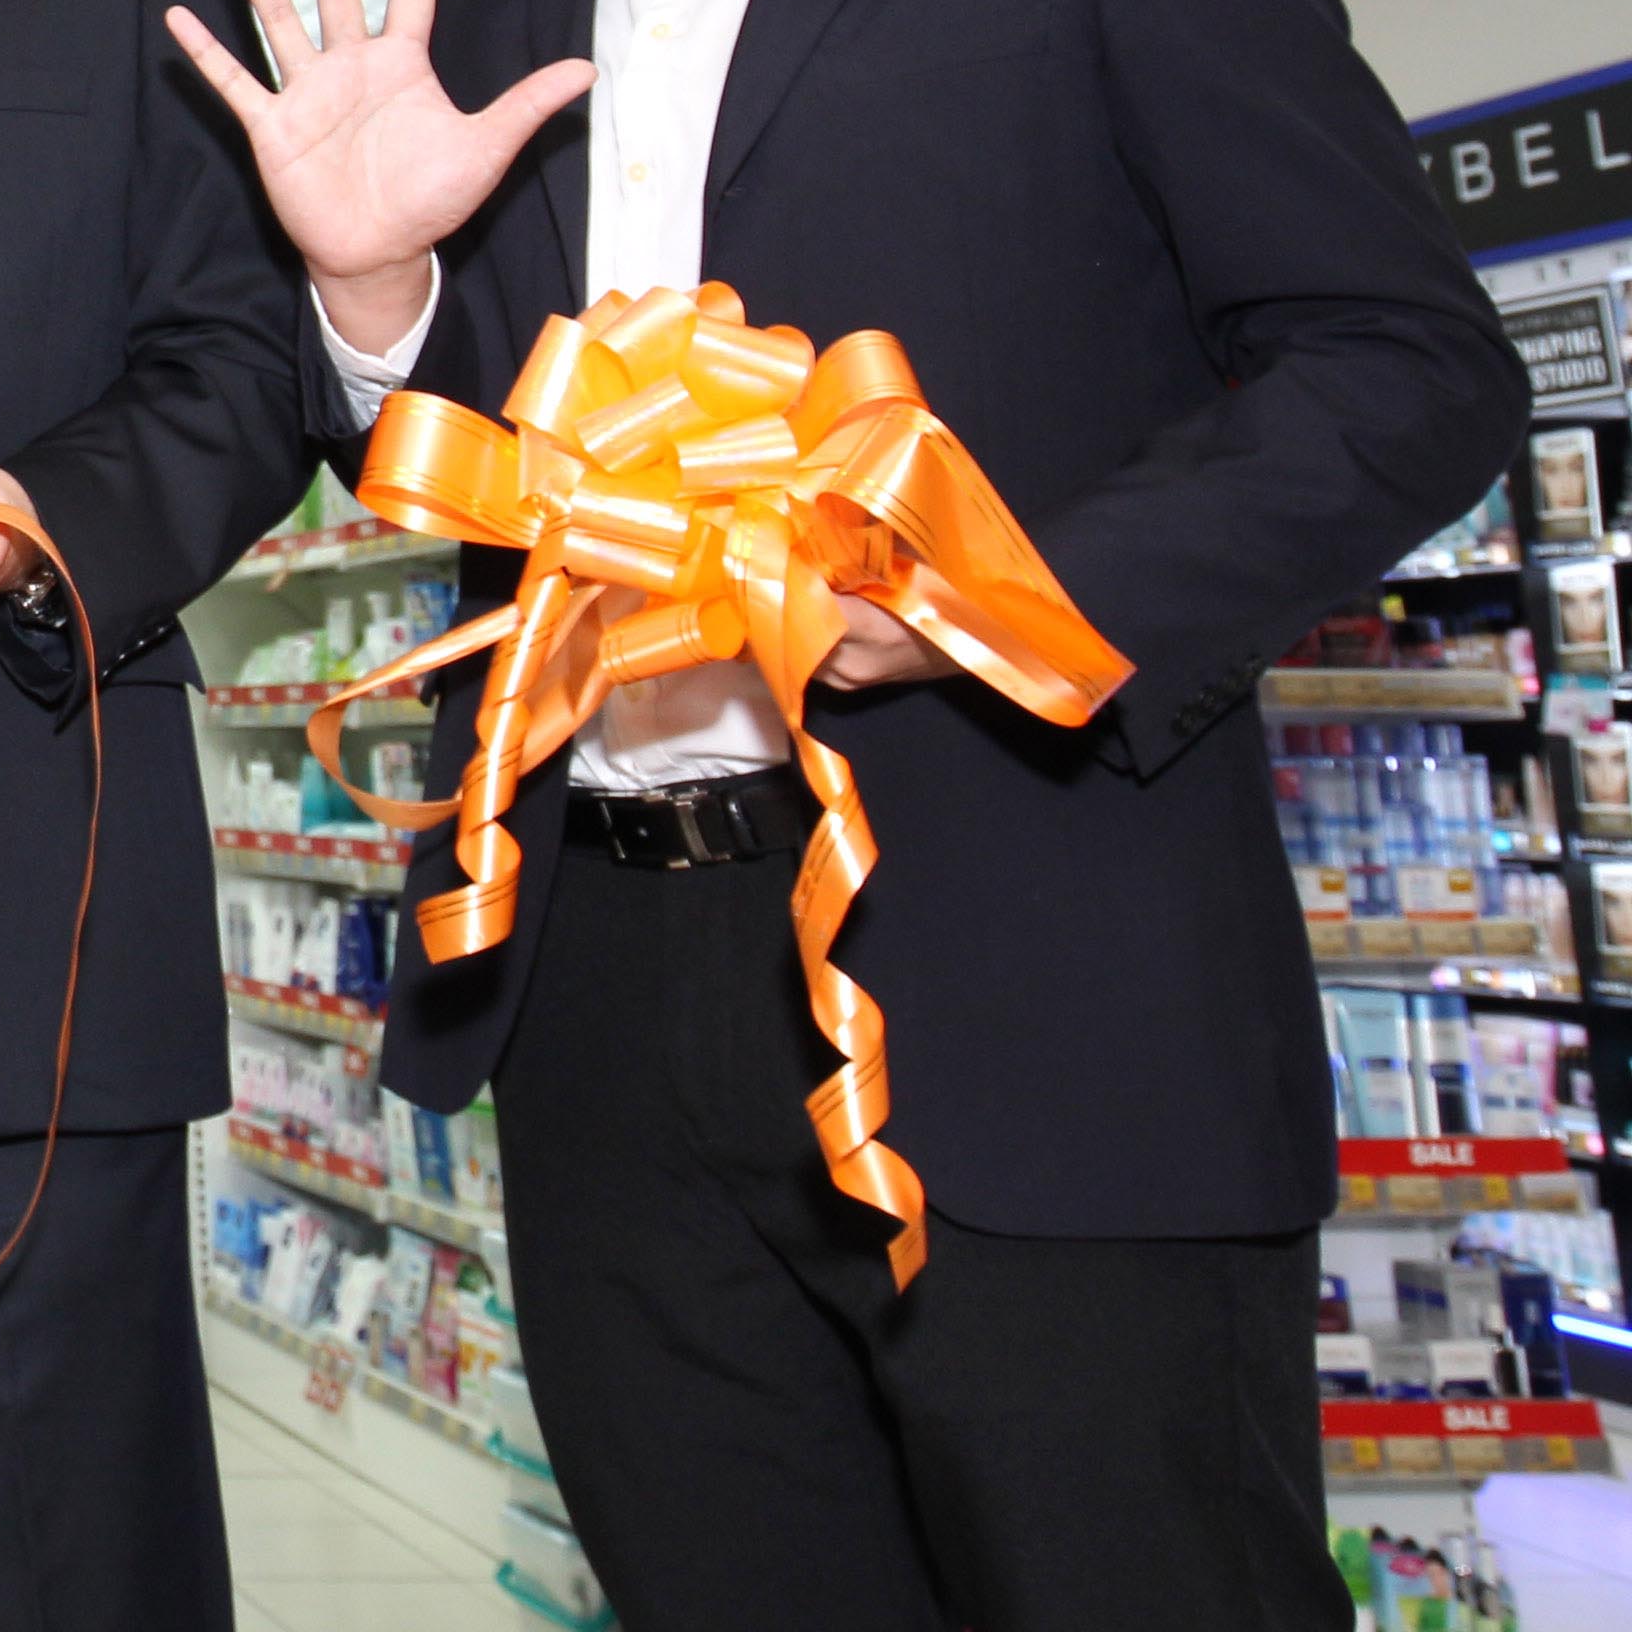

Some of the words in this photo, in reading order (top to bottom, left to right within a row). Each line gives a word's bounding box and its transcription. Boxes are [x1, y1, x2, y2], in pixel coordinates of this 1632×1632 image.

[1419, 109, 1632, 202] BEL
[1410, 1141, 1474, 1167] SALE
[1442, 1405, 1510, 1430] SALE
